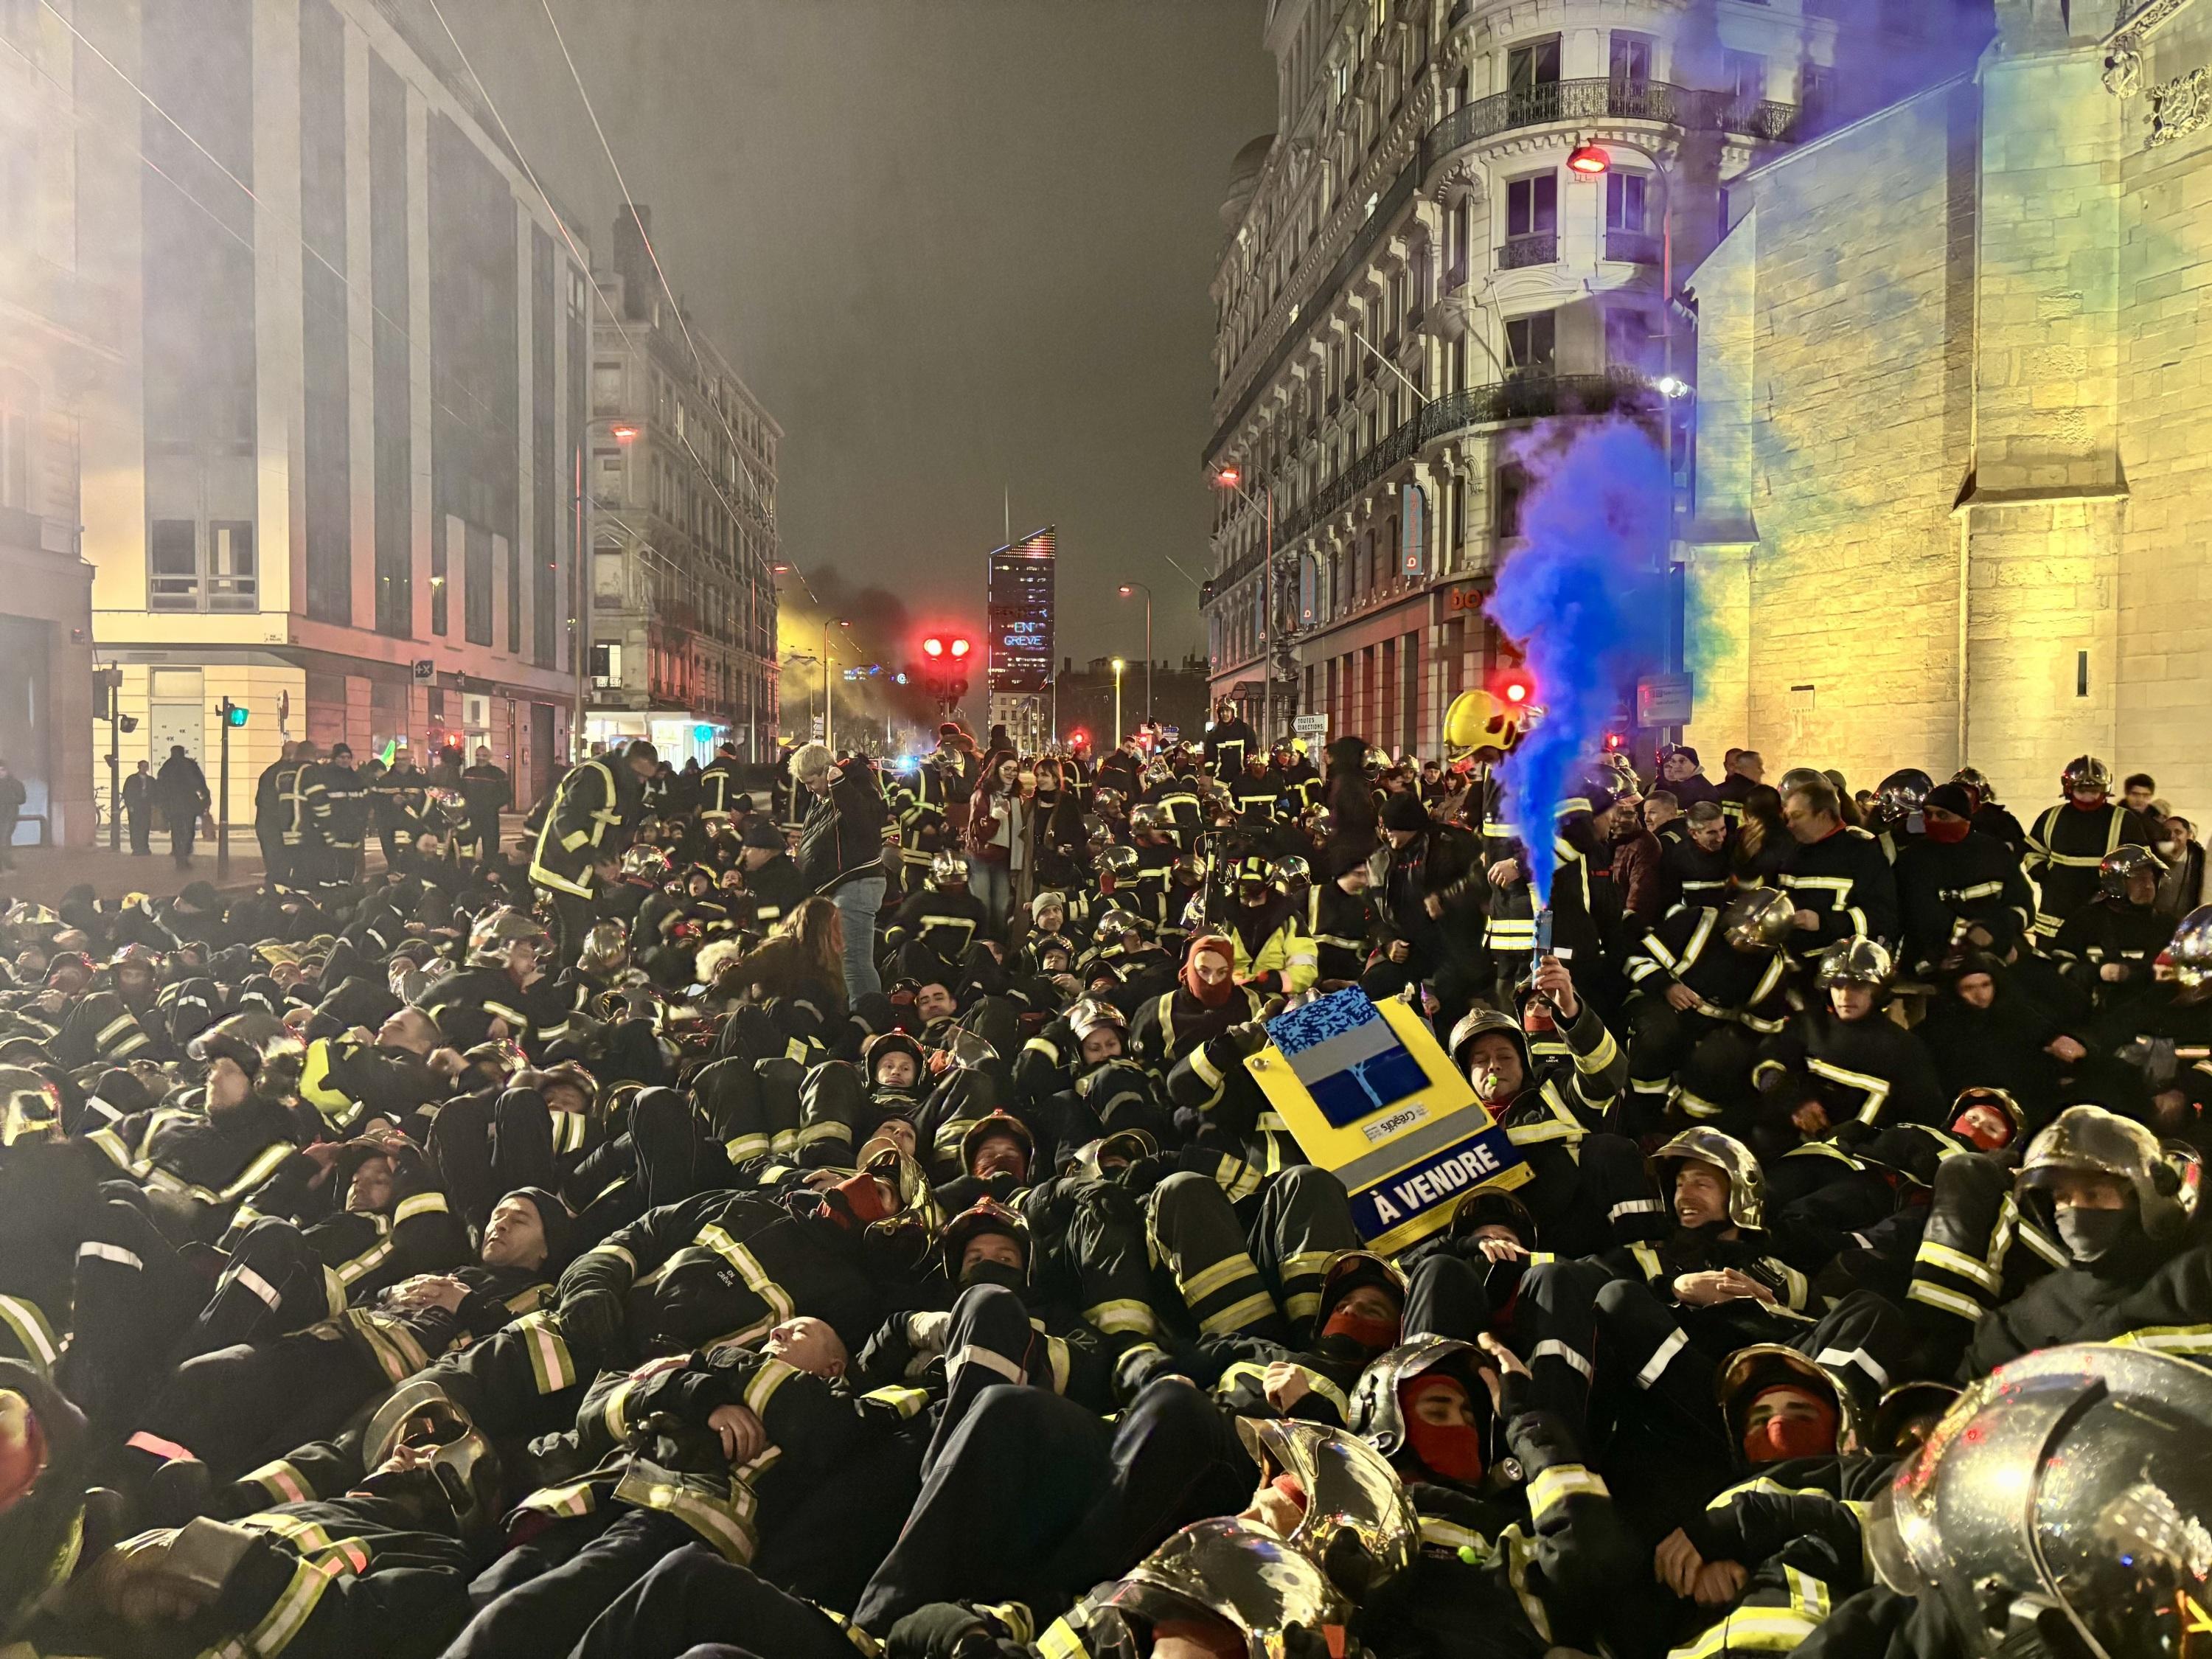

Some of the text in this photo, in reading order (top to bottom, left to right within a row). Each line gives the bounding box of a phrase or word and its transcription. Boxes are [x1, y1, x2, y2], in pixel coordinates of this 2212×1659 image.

[1369, 1190, 1401, 1225] À
[1393, 1142, 1501, 1211] VENDRE
[717, 1270, 734, 1287] GRÈVE
[726, 1270, 736, 1279] EN
